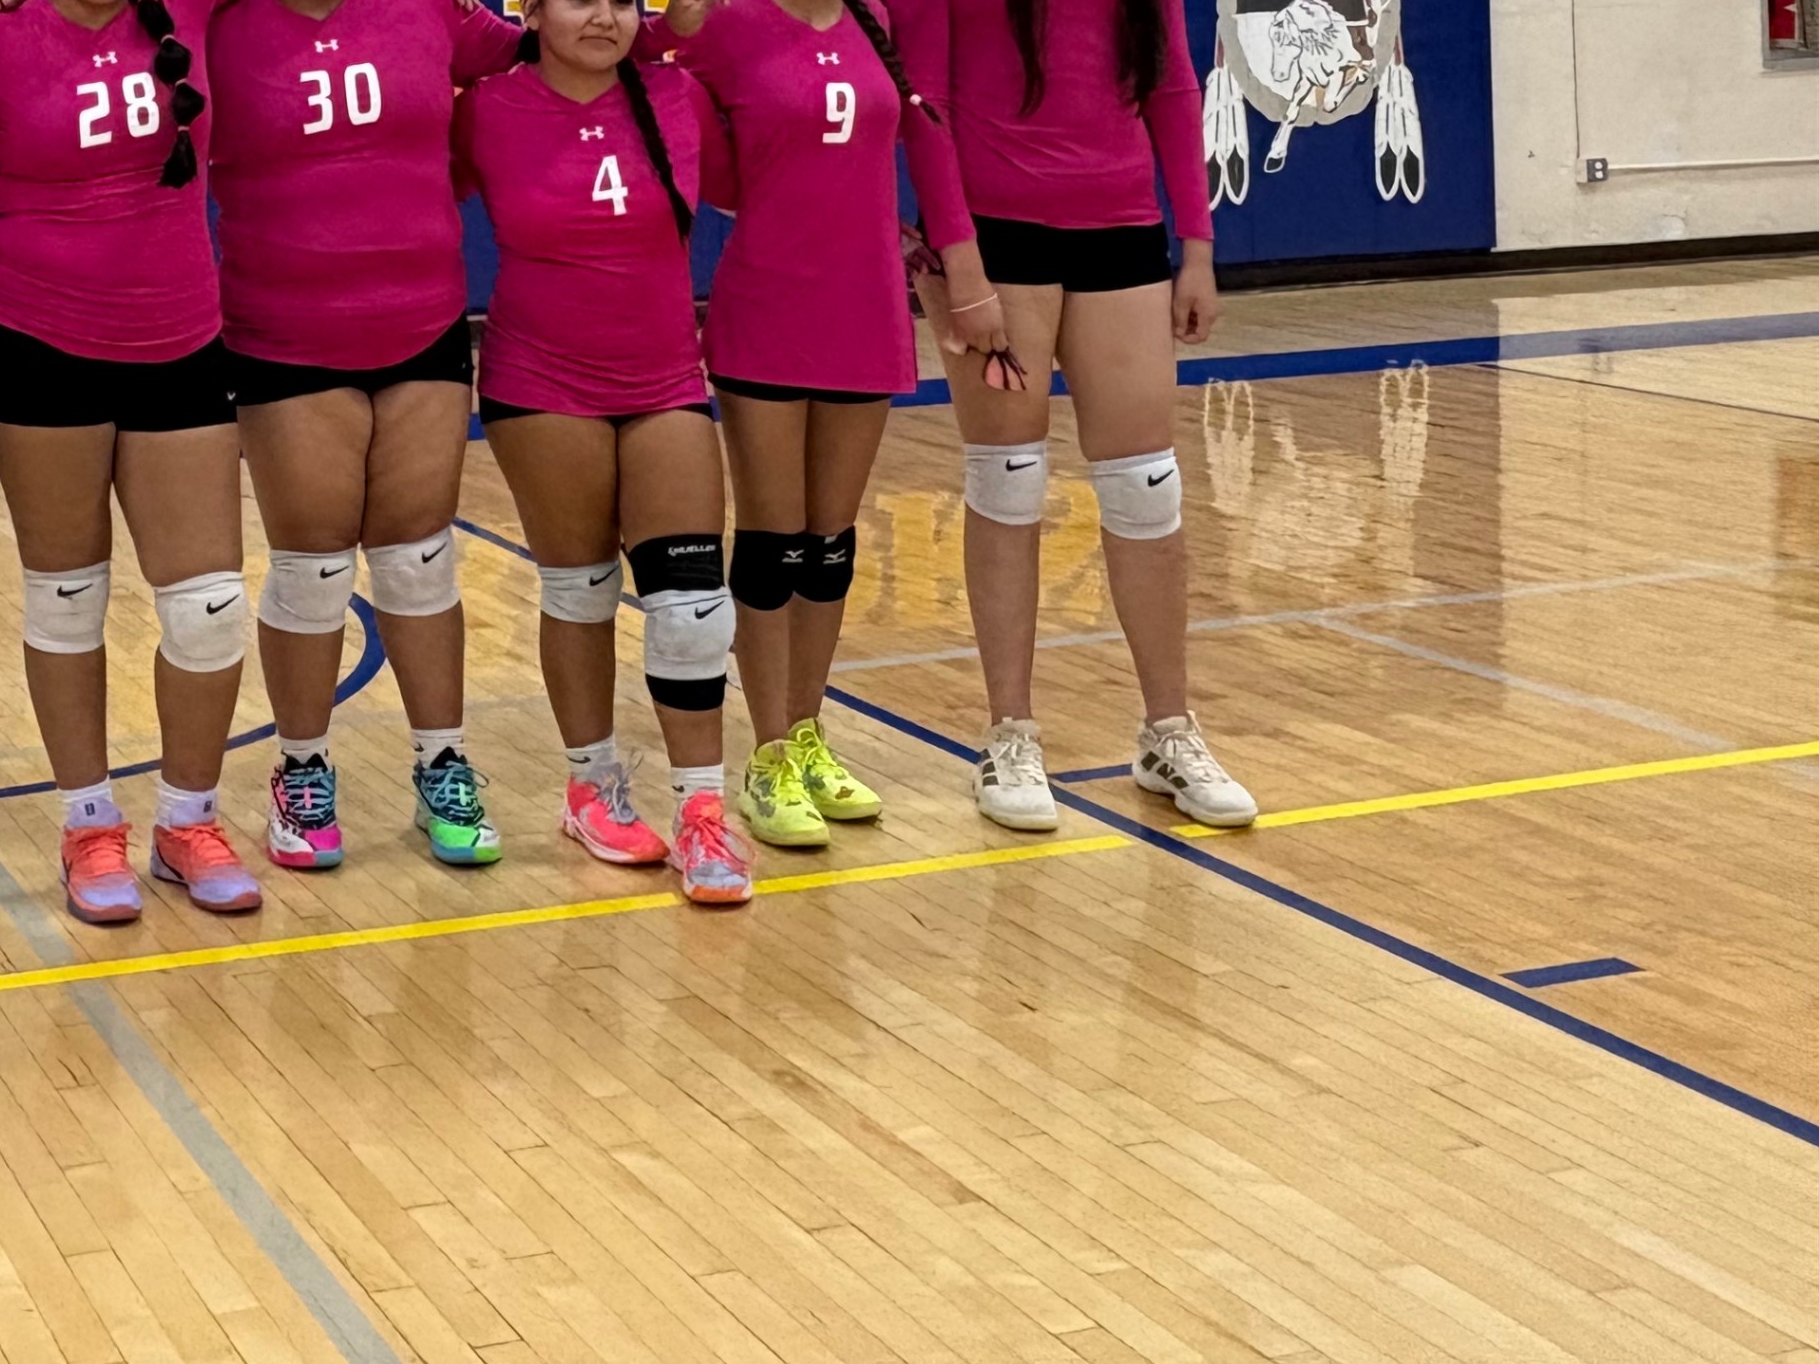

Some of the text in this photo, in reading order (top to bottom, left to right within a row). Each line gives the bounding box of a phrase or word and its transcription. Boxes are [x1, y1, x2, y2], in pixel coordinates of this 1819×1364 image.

[75, 72, 161, 150] 28
[299, 61, 383, 136] 30
[822, 81, 856, 145] 9
[591, 155, 629, 216] 4
